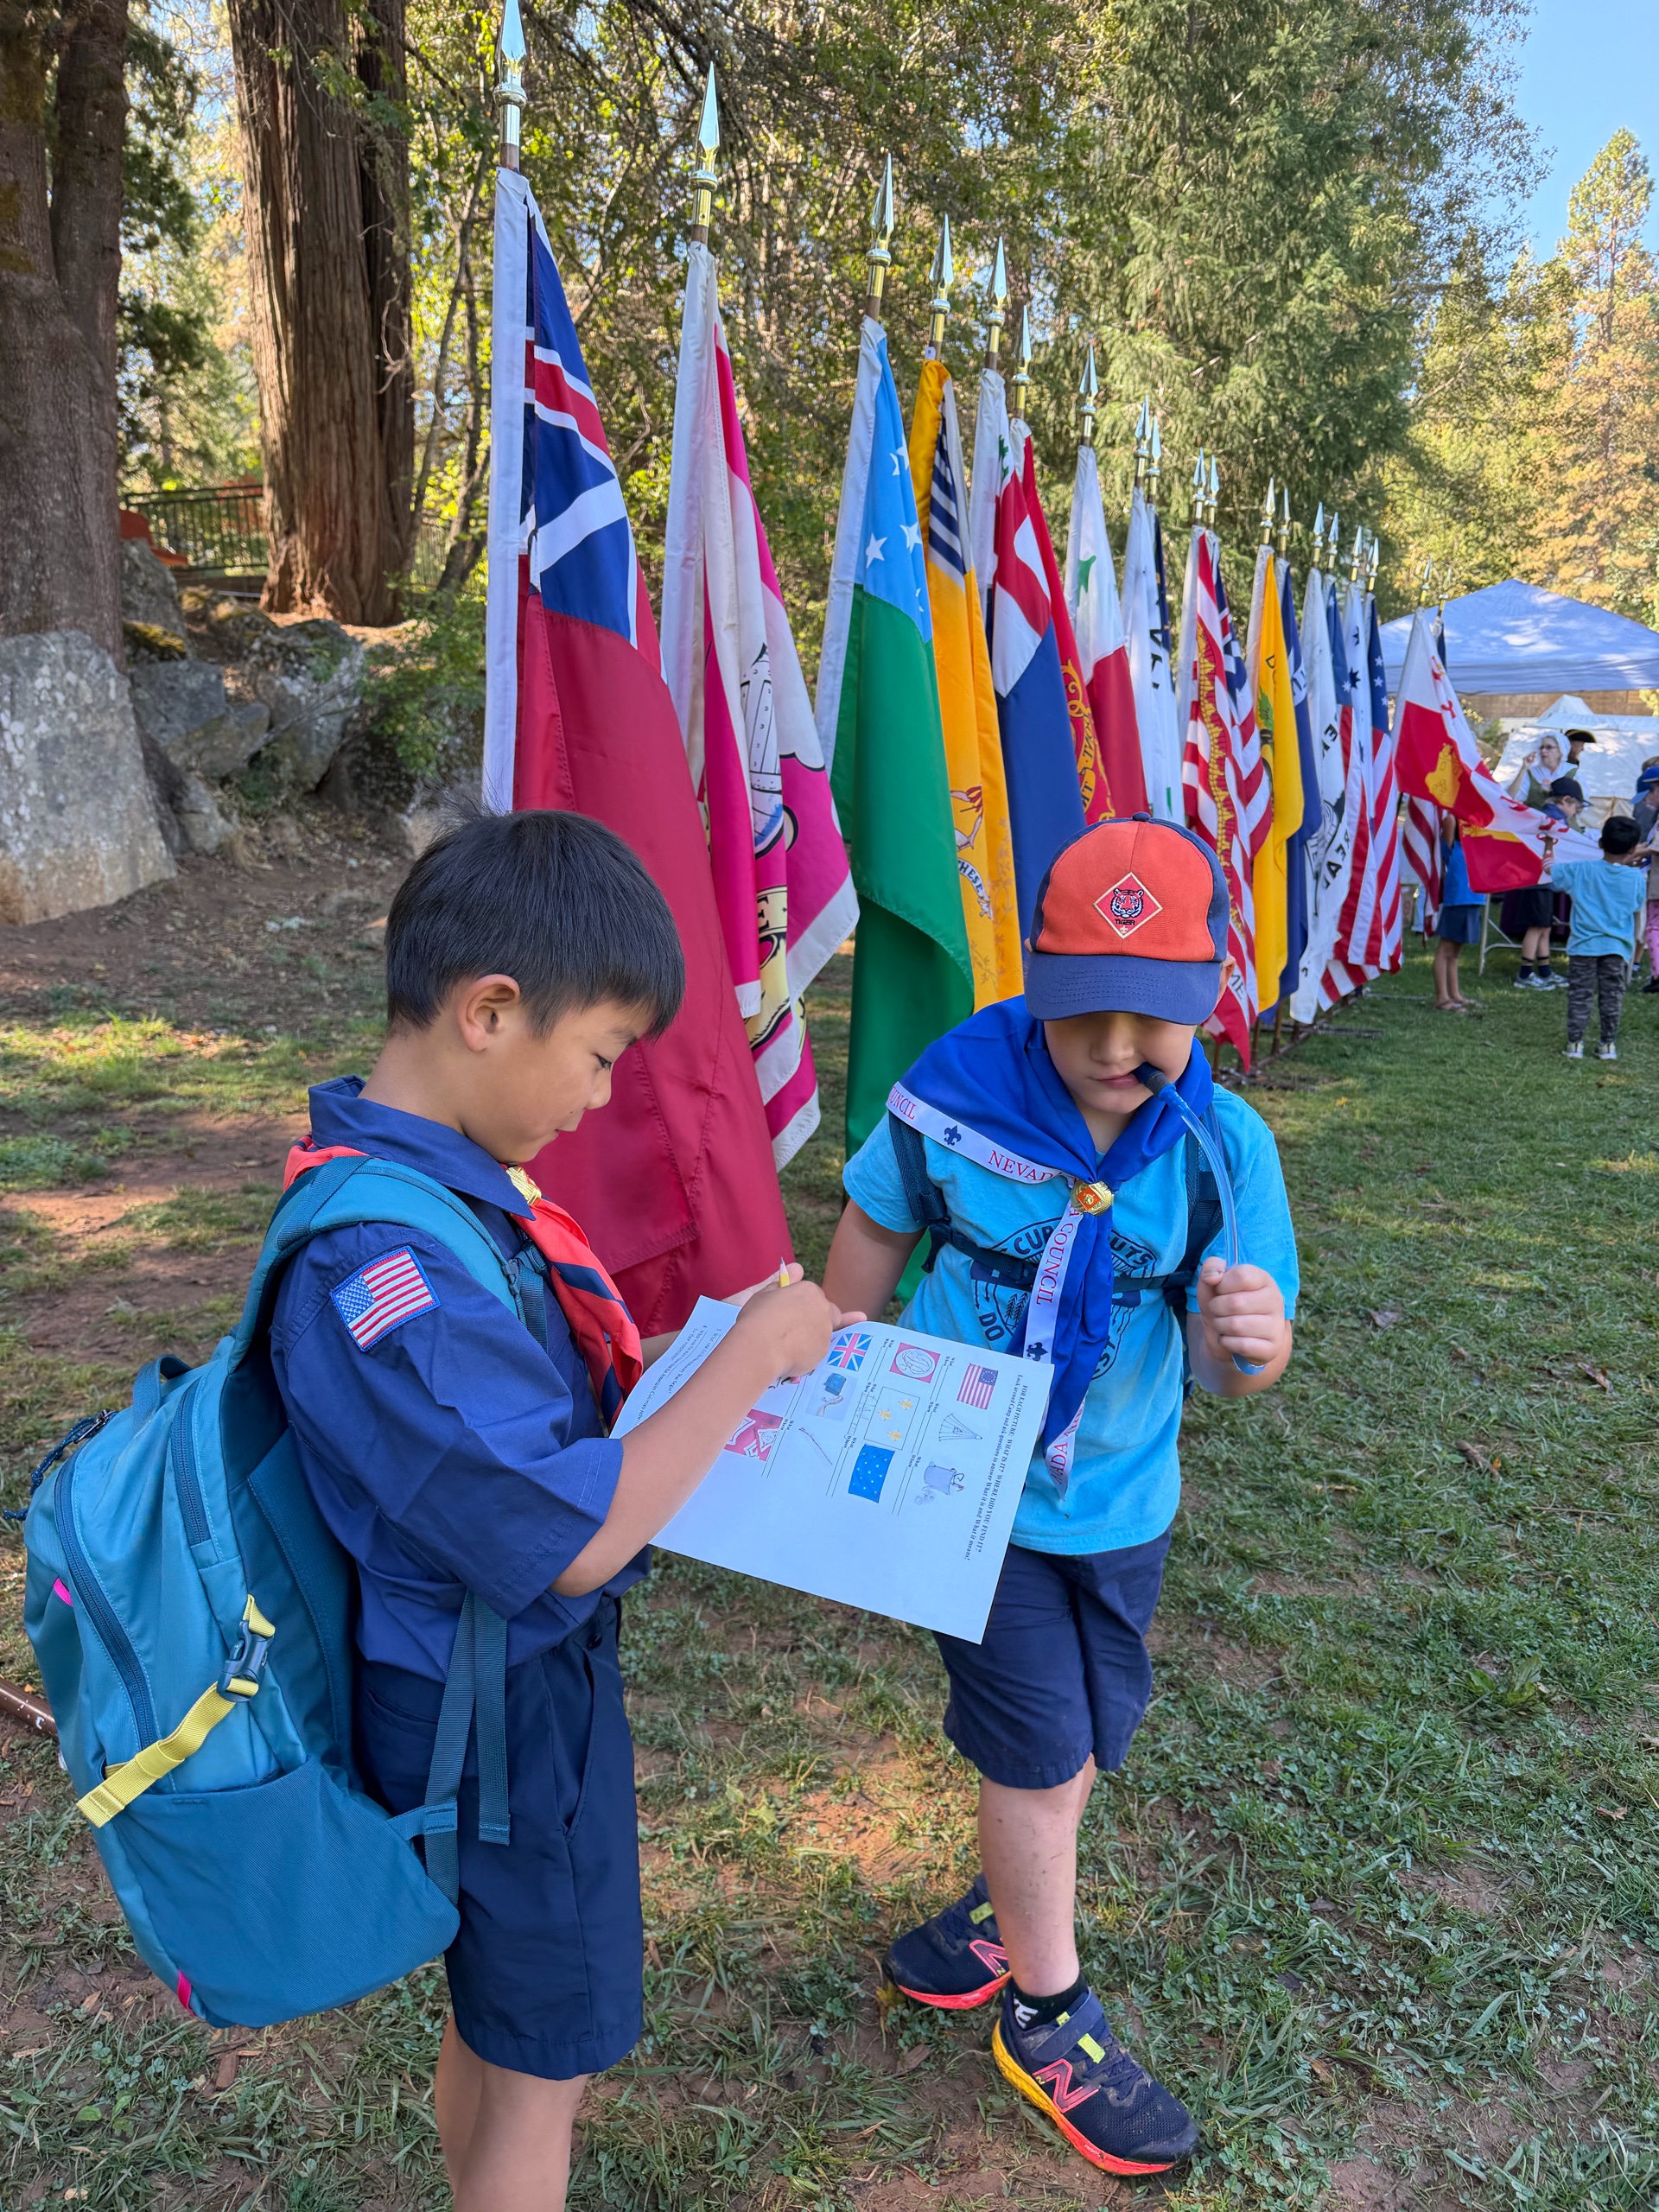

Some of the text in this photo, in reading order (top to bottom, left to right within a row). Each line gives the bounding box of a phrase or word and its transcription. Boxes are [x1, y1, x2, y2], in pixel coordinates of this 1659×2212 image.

[988, 1150, 1054, 1181] NEVAD
[1037, 1223, 1074, 1305] COUNCIL
[978, 1312, 1005, 1341] DO
[1005, 1402, 1014, 1417] Camp
[1002, 1439, 1012, 1456] WHAT
[982, 1481, 991, 1496] What
[990, 1473, 1002, 1497] WHERE
[987, 1497, 995, 1510] DID
[982, 1509, 992, 1524] YOU
[971, 1518, 981, 1534] What
[978, 1524, 988, 1541] FIND
[975, 1541, 983, 1552] IT?
